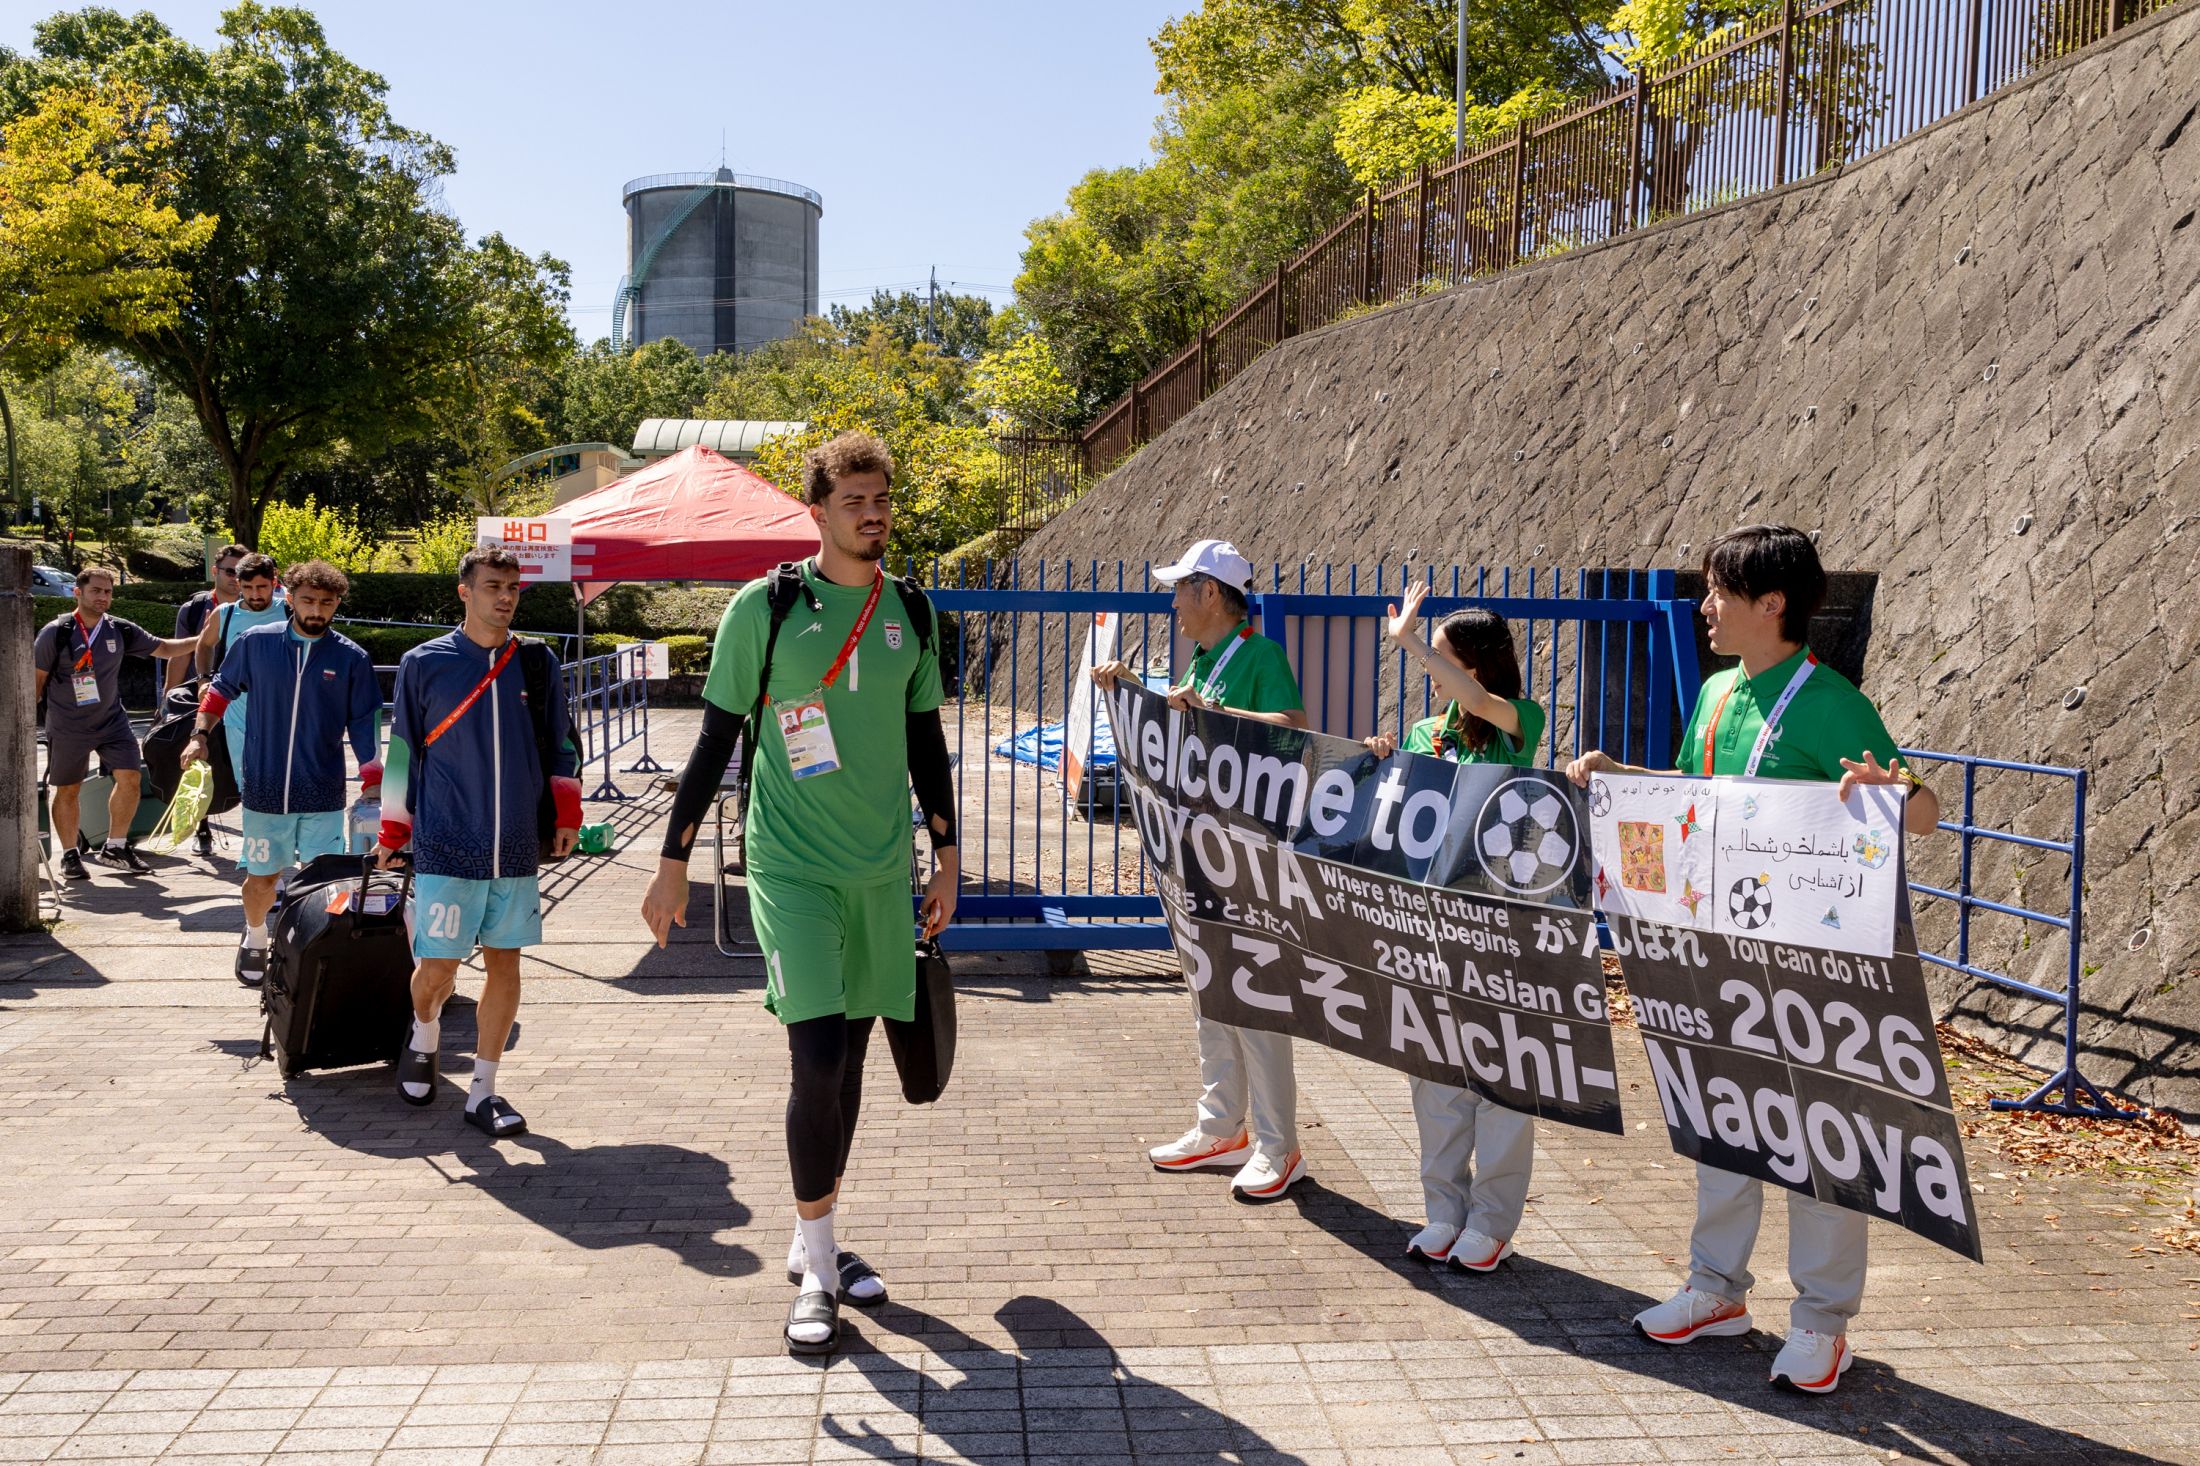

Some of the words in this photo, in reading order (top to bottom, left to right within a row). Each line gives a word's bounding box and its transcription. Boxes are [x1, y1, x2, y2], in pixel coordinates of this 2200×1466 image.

[503, 521, 547, 542] 出口
[1105, 688, 1355, 836] Welcome
[1370, 766, 1450, 860] to
[246, 836, 270, 863] 23
[1121, 765, 1324, 921] TOYOTA
[1316, 862, 1384, 903] Where
[1388, 884, 1427, 912] the
[1430, 891, 1509, 928] future
[1325, 891, 1346, 914] of
[427, 902, 462, 939] 20
[770, 949, 787, 998] 1
[1723, 933, 1769, 965] You
[1774, 944, 1817, 976] can
[1821, 950, 1853, 984] do
[1373, 939, 1452, 988] 28th
[1462, 960, 1563, 1014] Asian
[1719, 979, 1937, 1097] 2026
